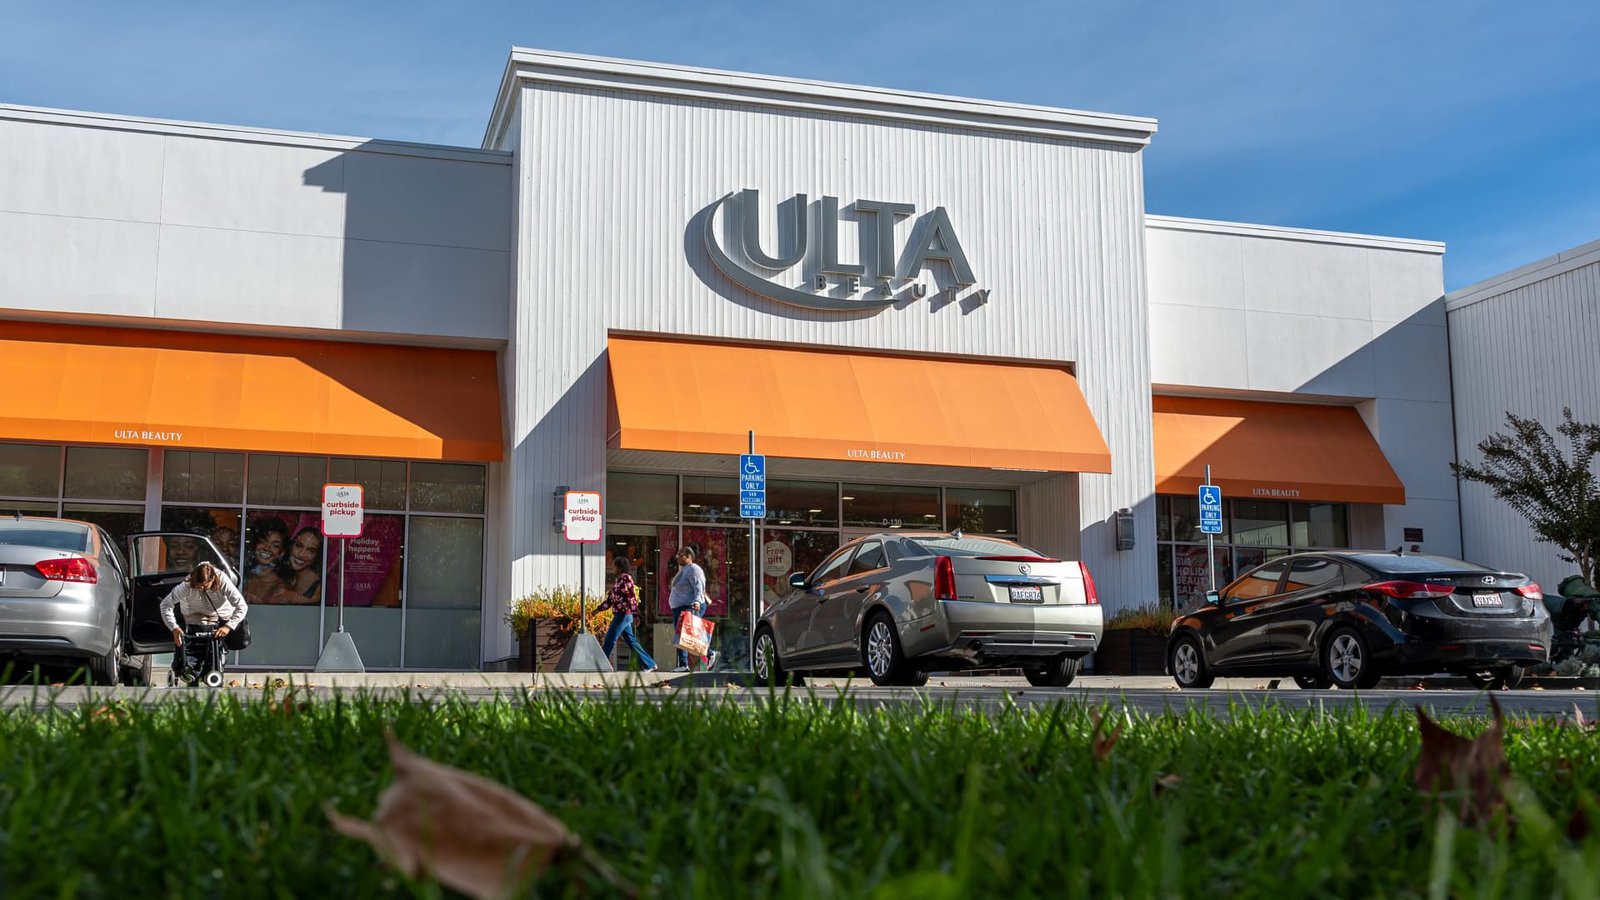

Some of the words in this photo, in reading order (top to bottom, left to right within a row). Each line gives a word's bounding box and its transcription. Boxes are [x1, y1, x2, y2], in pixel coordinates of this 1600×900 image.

[741, 188, 977, 287] ULTA
[814, 274, 991, 304] BEAUTY
[114, 429, 139, 439] ULTA
[141, 431, 183, 441] BEAUTY
[847, 449, 869, 458] ULTA
[870, 450, 906, 460] BEAUTY
[741, 474, 764, 482] PARKING
[745, 482, 760, 490] ONLY
[1252, 488, 1271, 497] ULTA
[1271, 489, 1301, 497] BEAUTY
[326, 501, 360, 509] curbside
[329, 508, 356, 516] pickup
[568, 507, 599, 515] curbside
[1204, 511, 1217, 519] ONLY
[571, 514, 595, 523] pickup
[348, 545, 380, 554] happens
[766, 547, 785, 555] Free
[768, 556, 783, 565] gift
